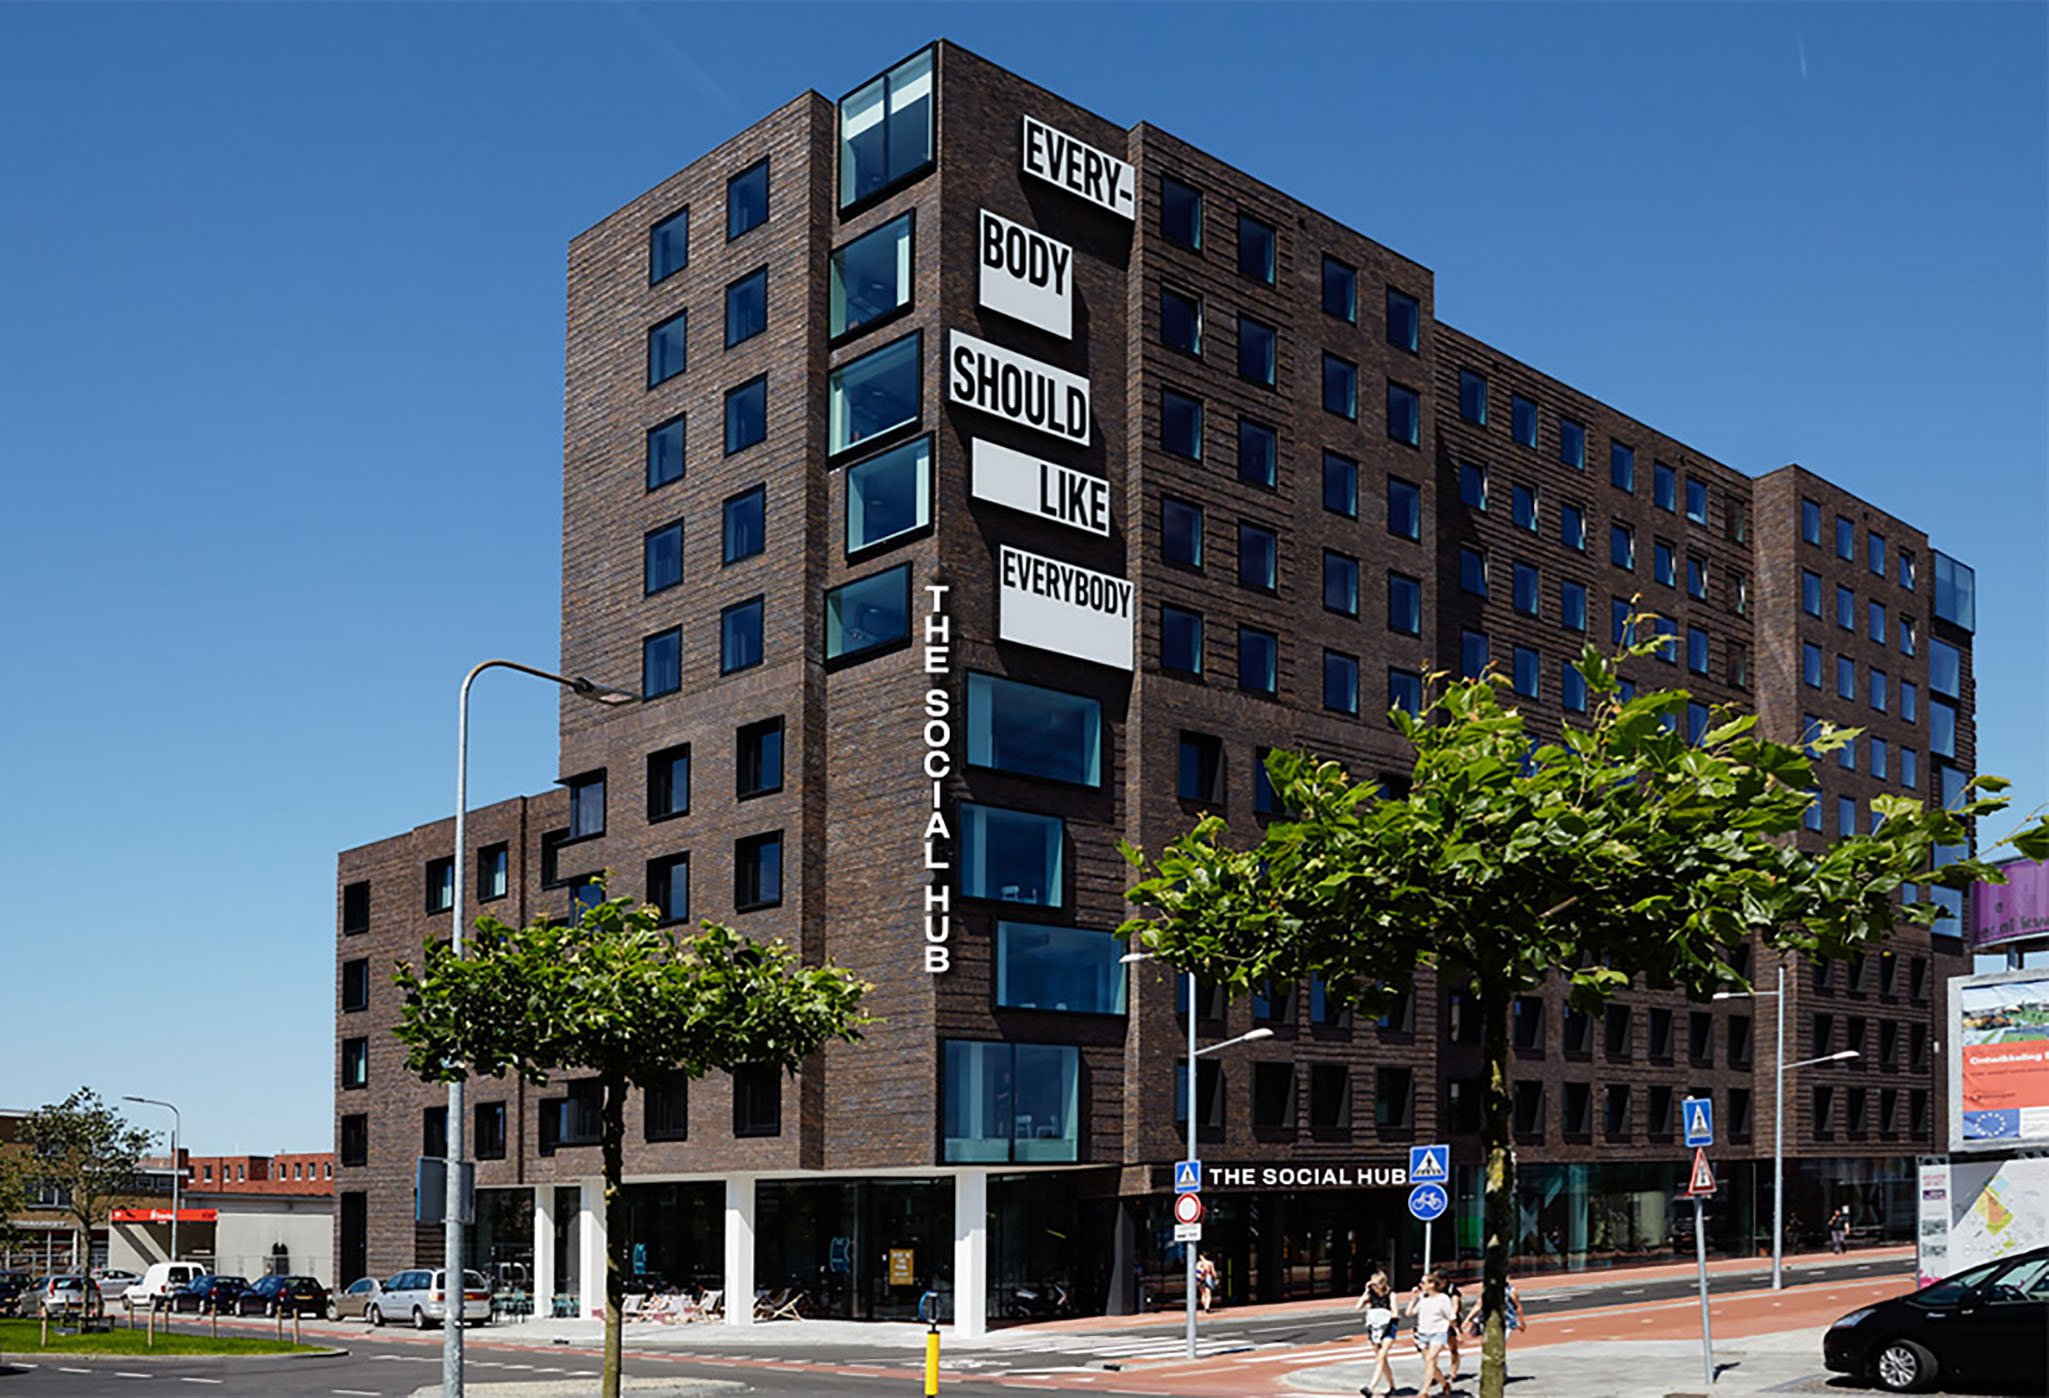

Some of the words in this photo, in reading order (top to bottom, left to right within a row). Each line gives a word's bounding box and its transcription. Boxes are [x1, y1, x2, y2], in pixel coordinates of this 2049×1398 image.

[1026, 120, 1133, 208] EVERY-
[983, 214, 1071, 296] BODY
[953, 345, 1087, 439] SHOULD
[1040, 464, 1107, 532] LIKE
[1003, 549, 1132, 618] EVERYBODY
[924, 585, 949, 673] THE
[923, 689, 951, 869] SOCIAL
[924, 884, 950, 973] HUB
[1208, 1167, 1256, 1186] THE
[1261, 1167, 1352, 1186] SOCIAL
[1356, 1167, 1408, 1186] HUB
